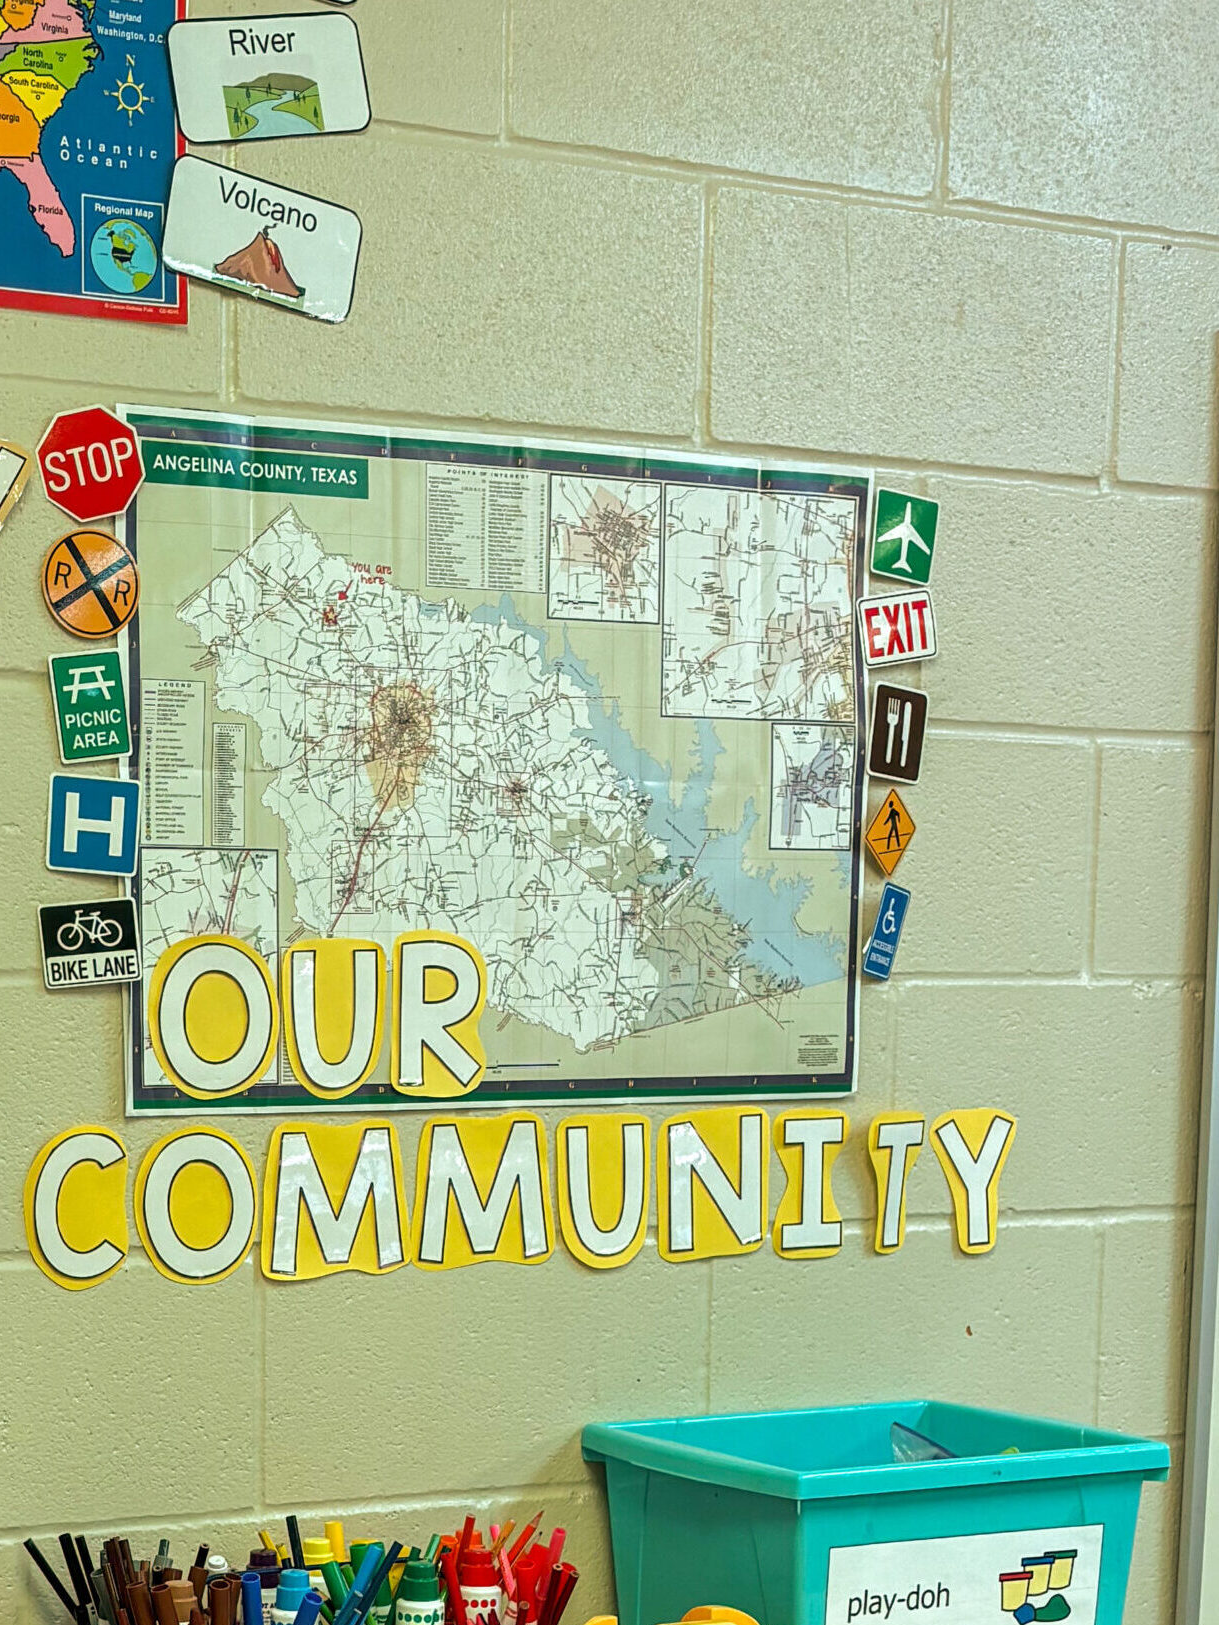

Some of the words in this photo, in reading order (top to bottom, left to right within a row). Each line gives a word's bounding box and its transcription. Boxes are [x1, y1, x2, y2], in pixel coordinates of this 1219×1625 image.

[109, 10, 142, 23] Maryland
[41, 22, 69, 35] Virginia
[97, 25, 147, 43] Washington,
[22, 46, 44, 59] North
[228, 29, 296, 56] River
[23, 57, 53, 71] Carolina
[9, 76, 29, 88] South
[31, 79, 59, 92] Carolina
[60, 135, 158, 160] Atlantic
[60, 149, 128, 169] Ocean
[38, 204, 64, 216] Florida
[94, 202, 133, 217] Regional
[135, 207, 154, 219] Map
[219, 175, 319, 234] Volcano
[44, 437, 133, 493] STOP
[153, 455, 235, 475] ANGELINA
[240, 461, 306, 483] COUNTY,
[311, 467, 358, 485] TEXAS
[54, 563, 71, 588] R
[361, 574, 386, 584] here
[375, 564, 392, 575] are
[113, 579, 131, 606] R
[864, 600, 928, 658] EXIT
[64, 709, 122, 729] PICNIC
[72, 733, 120, 750] AREA
[63, 791, 126, 857] H
[50, 960, 89, 982] BIKE
[92, 955, 136, 978] LANE
[158, 939, 482, 1092] OUR
[33, 1113, 1014, 1280] COMMUNITY
[847, 1581, 950, 1623] play-doh
